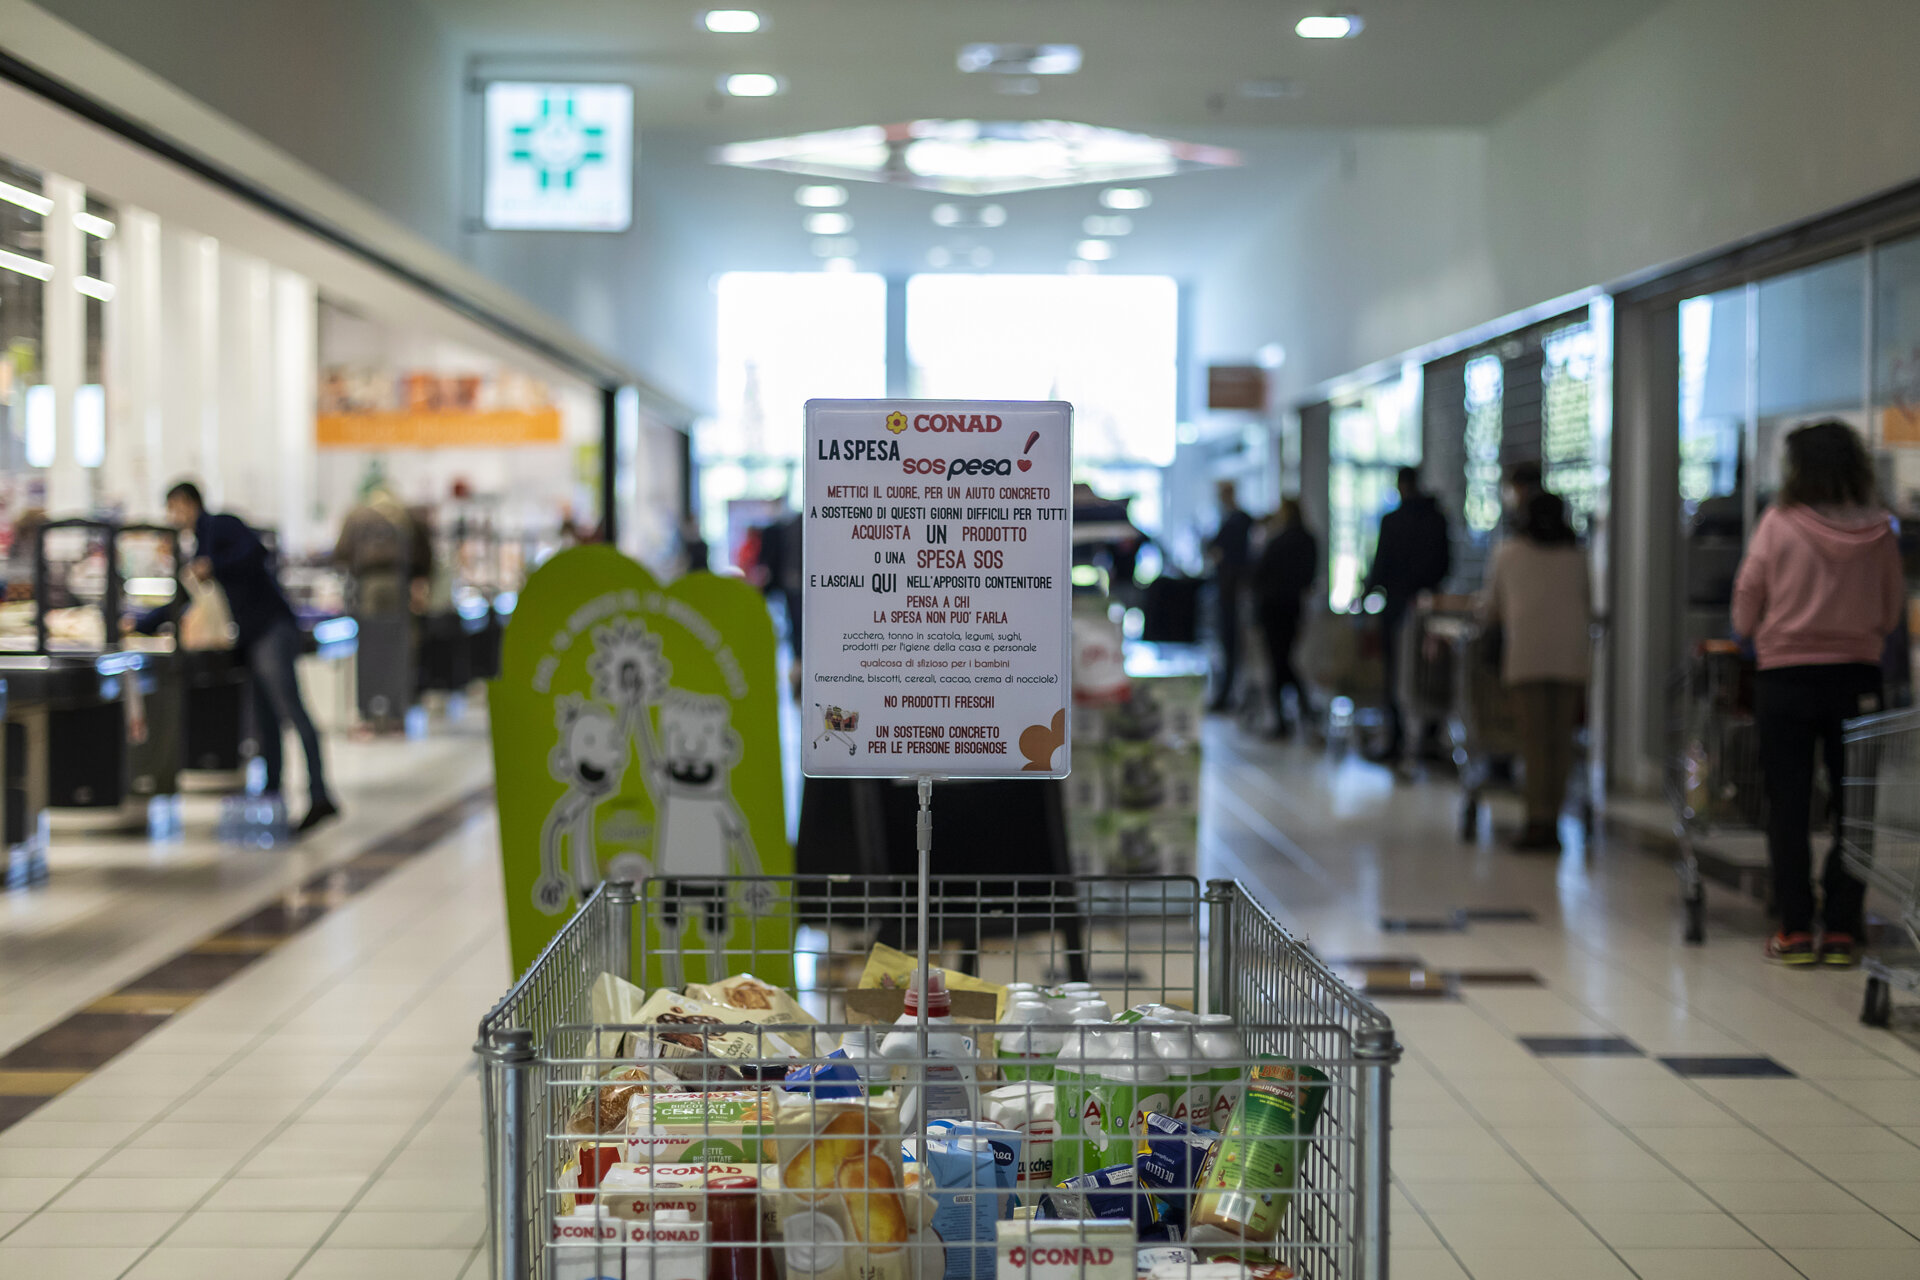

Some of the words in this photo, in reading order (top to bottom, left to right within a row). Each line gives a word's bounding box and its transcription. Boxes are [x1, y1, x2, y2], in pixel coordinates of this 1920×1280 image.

[914, 414, 1002, 432] CONAD
[819, 440, 842, 460] LA
[844, 440, 900, 461] SPESA
[828, 486, 868, 498] METTICI
[874, 486, 882, 498] IL
[887, 486, 920, 499] CUORE,
[925, 487, 942, 499] PER
[948, 487, 960, 499] UN
[966, 487, 995, 499] AIUTO
[1000, 487, 1050, 499] CONCRETO
[811, 506, 817, 520] A
[822, 506, 872, 520] SOSTEGNO
[877, 507, 886, 519] DI
[891, 507, 925, 520] QUESTI
[931, 508, 962, 519] GIORNI
[967, 508, 1008, 520] DIFFICILI
[1014, 508, 1031, 520] PER
[1037, 508, 1066, 520] TUTTI
[852, 525, 910, 540] ACQUISTA
[927, 525, 946, 544] UN
[963, 527, 1026, 542] PRODOTTO
[875, 552, 881, 563] O
[886, 552, 905, 564] UNA
[917, 550, 966, 568] SPESA
[974, 550, 1003, 569] SOS
[811, 575, 816, 587] E
[821, 575, 864, 587] LASCIALI
[872, 573, 896, 594] QUI
[907, 576, 980, 588] NELL'APPOSITO
[985, 576, 1052, 589] CONTENITORE
[907, 596, 938, 608] PENSA
[943, 596, 950, 608] A
[955, 596, 969, 608] CHI
[874, 611, 886, 623] LA
[891, 611, 922, 623] SPESA
[926, 611, 945, 623] NON
[951, 611, 971, 623] PUO'
[976, 612, 1007, 624] FARLA
[843, 631, 884, 642] zucchero,
[888, 632, 913, 642] tonno
[917, 632, 924, 642] in
[927, 632, 962, 642] scatola,
[965, 632, 994, 641] legumi,
[998, 632, 1022, 641] sughi,
[843, 642, 878, 652] prodotti
[882, 643, 896, 652] per
[900, 642, 930, 652] l'igiene
[934, 643, 955, 653] della
[959, 643, 981, 653] casa
[984, 643, 990, 653] e
[994, 643, 1036, 653] personale
[860, 658, 902, 668] qualcosa
[905, 659, 914, 669] di
[917, 659, 948, 669] sfizioso
[951, 659, 966, 668] per
[969, 660, 971, 669] i
[975, 659, 1009, 668] bambini
[815, 673, 864, 683] (merendine,
[868, 674, 901, 683] biscotti,
[905, 674, 936, 683] cereali,
[940, 674, 971, 683] cacao,
[975, 674, 1001, 683] crema
[1005, 675, 1013, 683] di
[1017, 674, 1058, 683] nocciole)
[885, 696, 897, 707] NO
[902, 696, 950, 708] PRODOTTI
[955, 696, 994, 708] FRESCHI
[876, 726, 889, 738] UN
[894, 726, 944, 738] SOSTEGNO
[949, 726, 999, 738] CONCRETO
[869, 741, 886, 753] PER
[891, 741, 902, 753] LE
[907, 741, 950, 753] PERSONE
[955, 742, 1007, 754] BISOGNOSE
[656, 1165, 742, 1175] CONAD
[562, 1226, 616, 1240] CONAD
[646, 1230, 700, 1242] CONAD
[1031, 1247, 1114, 1265] CONAD
